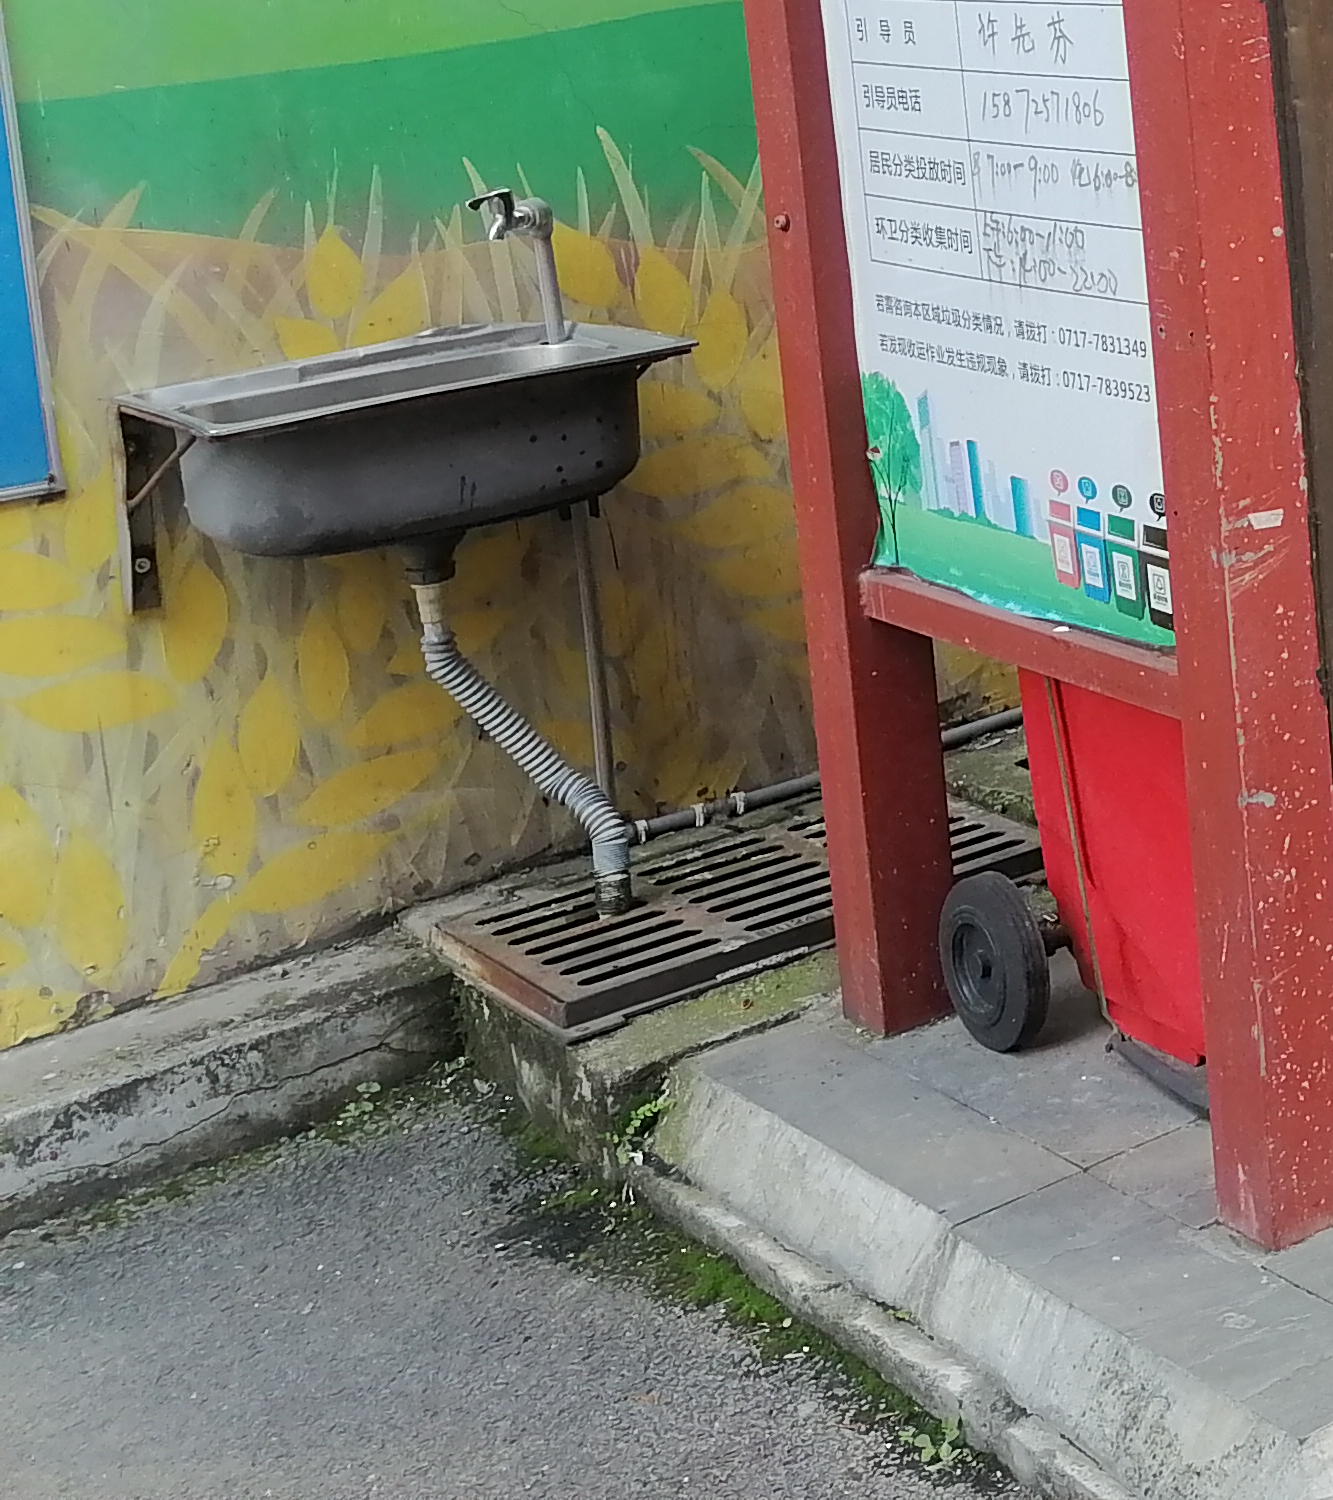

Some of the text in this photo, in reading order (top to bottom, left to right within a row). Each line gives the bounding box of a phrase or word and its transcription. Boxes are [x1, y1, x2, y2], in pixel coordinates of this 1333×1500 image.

[862, 83, 922, 113] 引导员电话
[869, 149, 967, 186] 居民分类投放时间
[875, 216, 974, 254] 环卫分类收集时间
